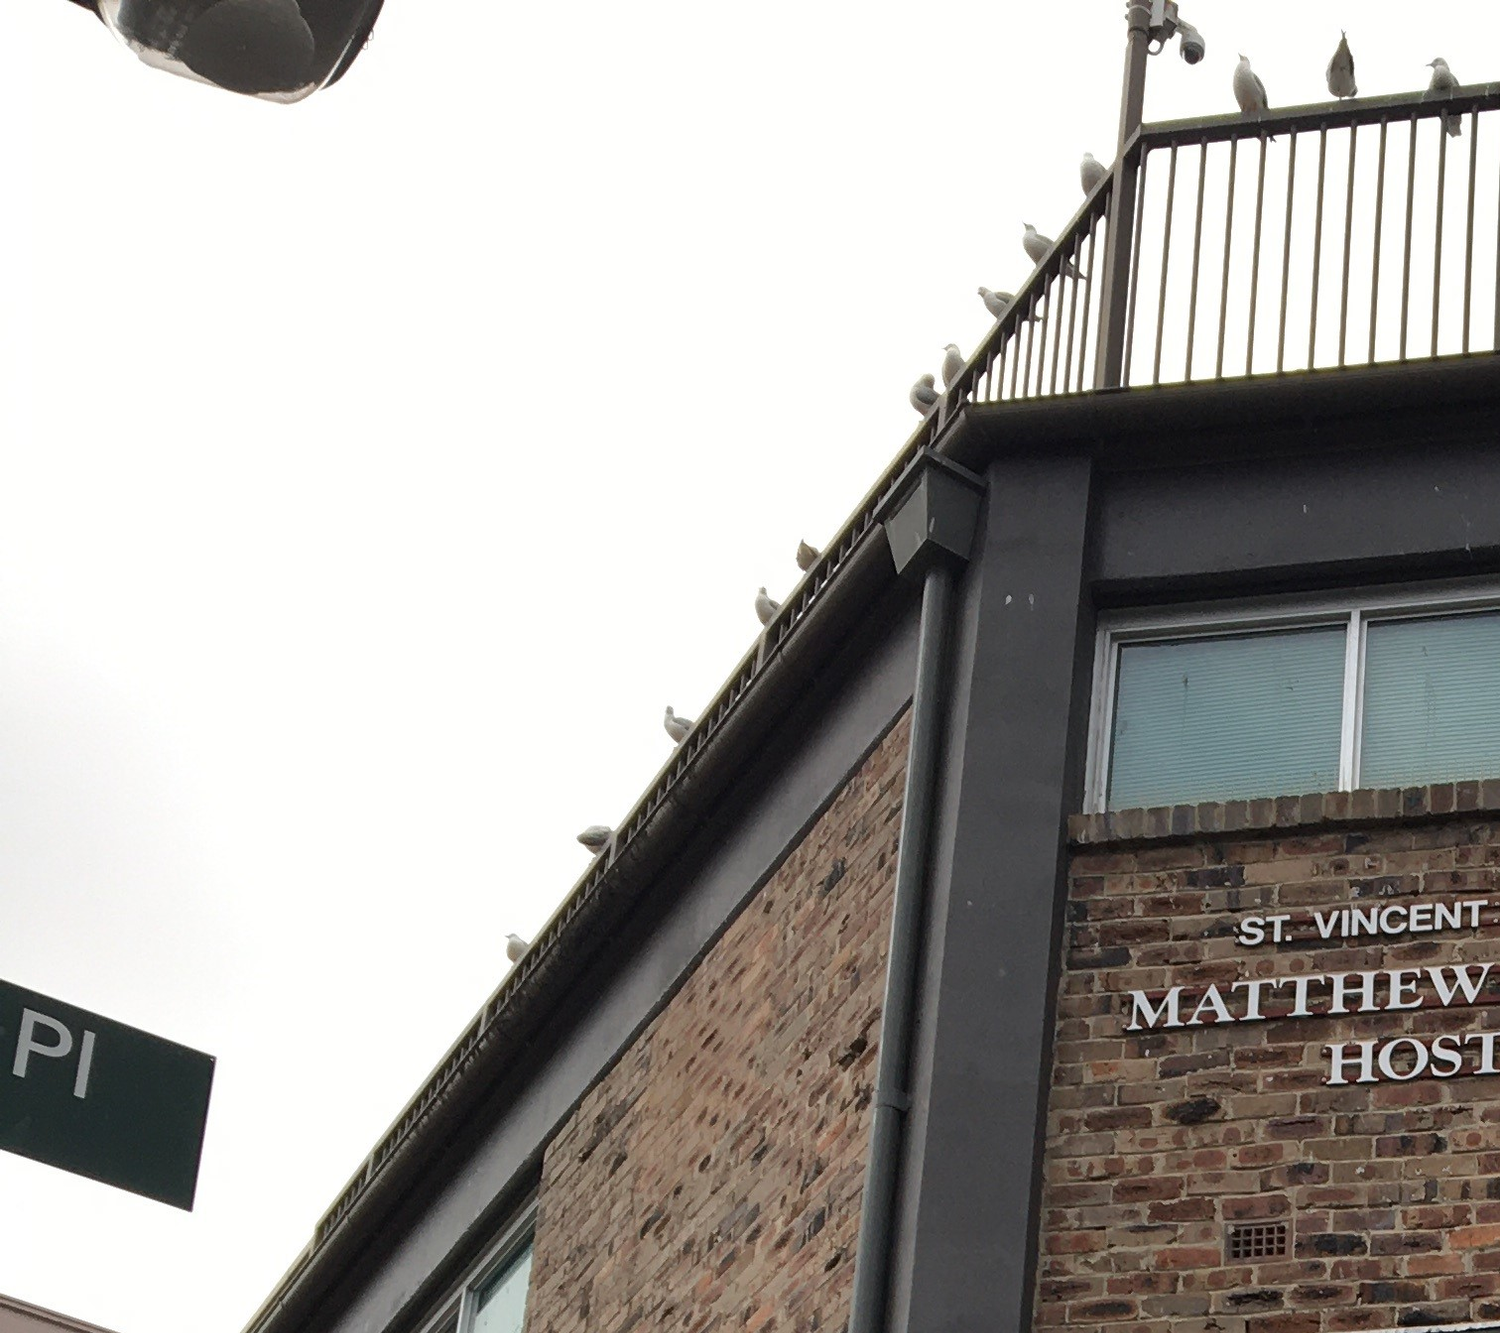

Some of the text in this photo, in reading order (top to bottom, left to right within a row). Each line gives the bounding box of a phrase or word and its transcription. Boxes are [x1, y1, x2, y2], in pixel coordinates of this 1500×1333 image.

[1237, 914, 1293, 946] ST.
[1313, 899, 1489, 939] VINCENT
[1125, 962, 1496, 1031] MATTHEW
